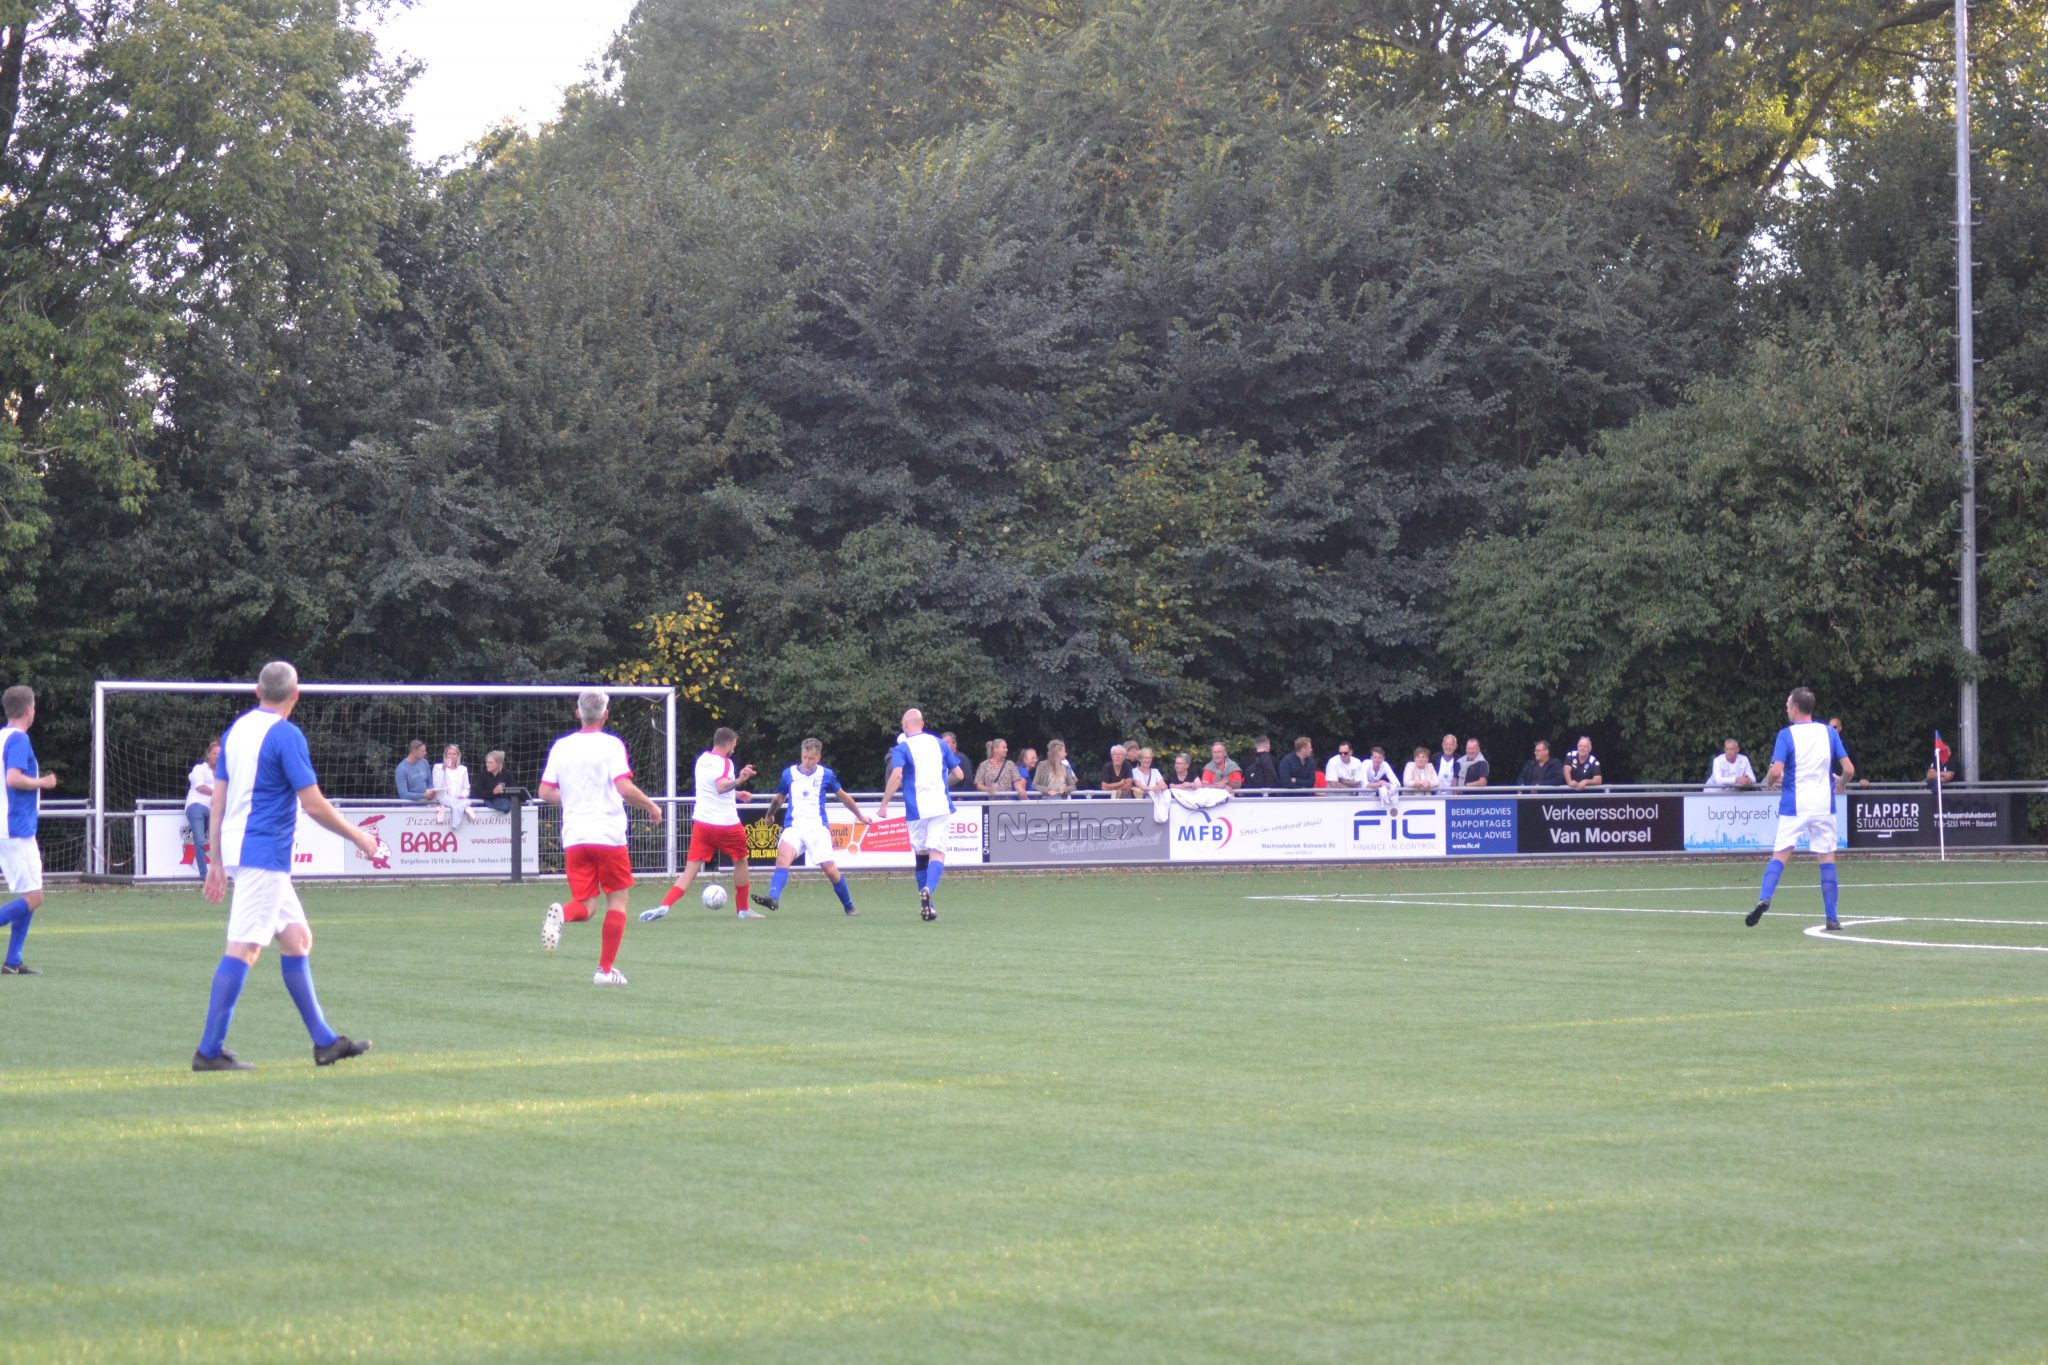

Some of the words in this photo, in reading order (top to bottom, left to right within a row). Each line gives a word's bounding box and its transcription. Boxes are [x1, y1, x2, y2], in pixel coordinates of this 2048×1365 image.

[1451, 807, 1512, 816] BEDRIJFSADVIES
[1542, 804, 1659, 821] Verkeersschool
[1707, 805, 1772, 826] burghgraef
[1856, 803, 1919, 818] FLAPPER
[405, 816, 451, 826] Pizzea
[997, 811, 1145, 842] Nedinox
[1451, 819, 1512, 828] RAPPORTAGES
[1856, 817, 1919, 829] STUKADOORS
[830, 825, 849, 837] oruit
[1177, 825, 1223, 841] MFB
[1451, 831, 1483, 840] FISCAAL
[1484, 831, 1512, 839] ADVIES
[1550, 828, 1580, 843] Van
[1585, 827, 1651, 843] Moorsel
[400, 831, 458, 853] BABA
[1353, 843, 1386, 851] FINANCE
[1399, 842, 1436, 850] CONTROL
[1452, 842, 1481, 850] www.fic.nl
